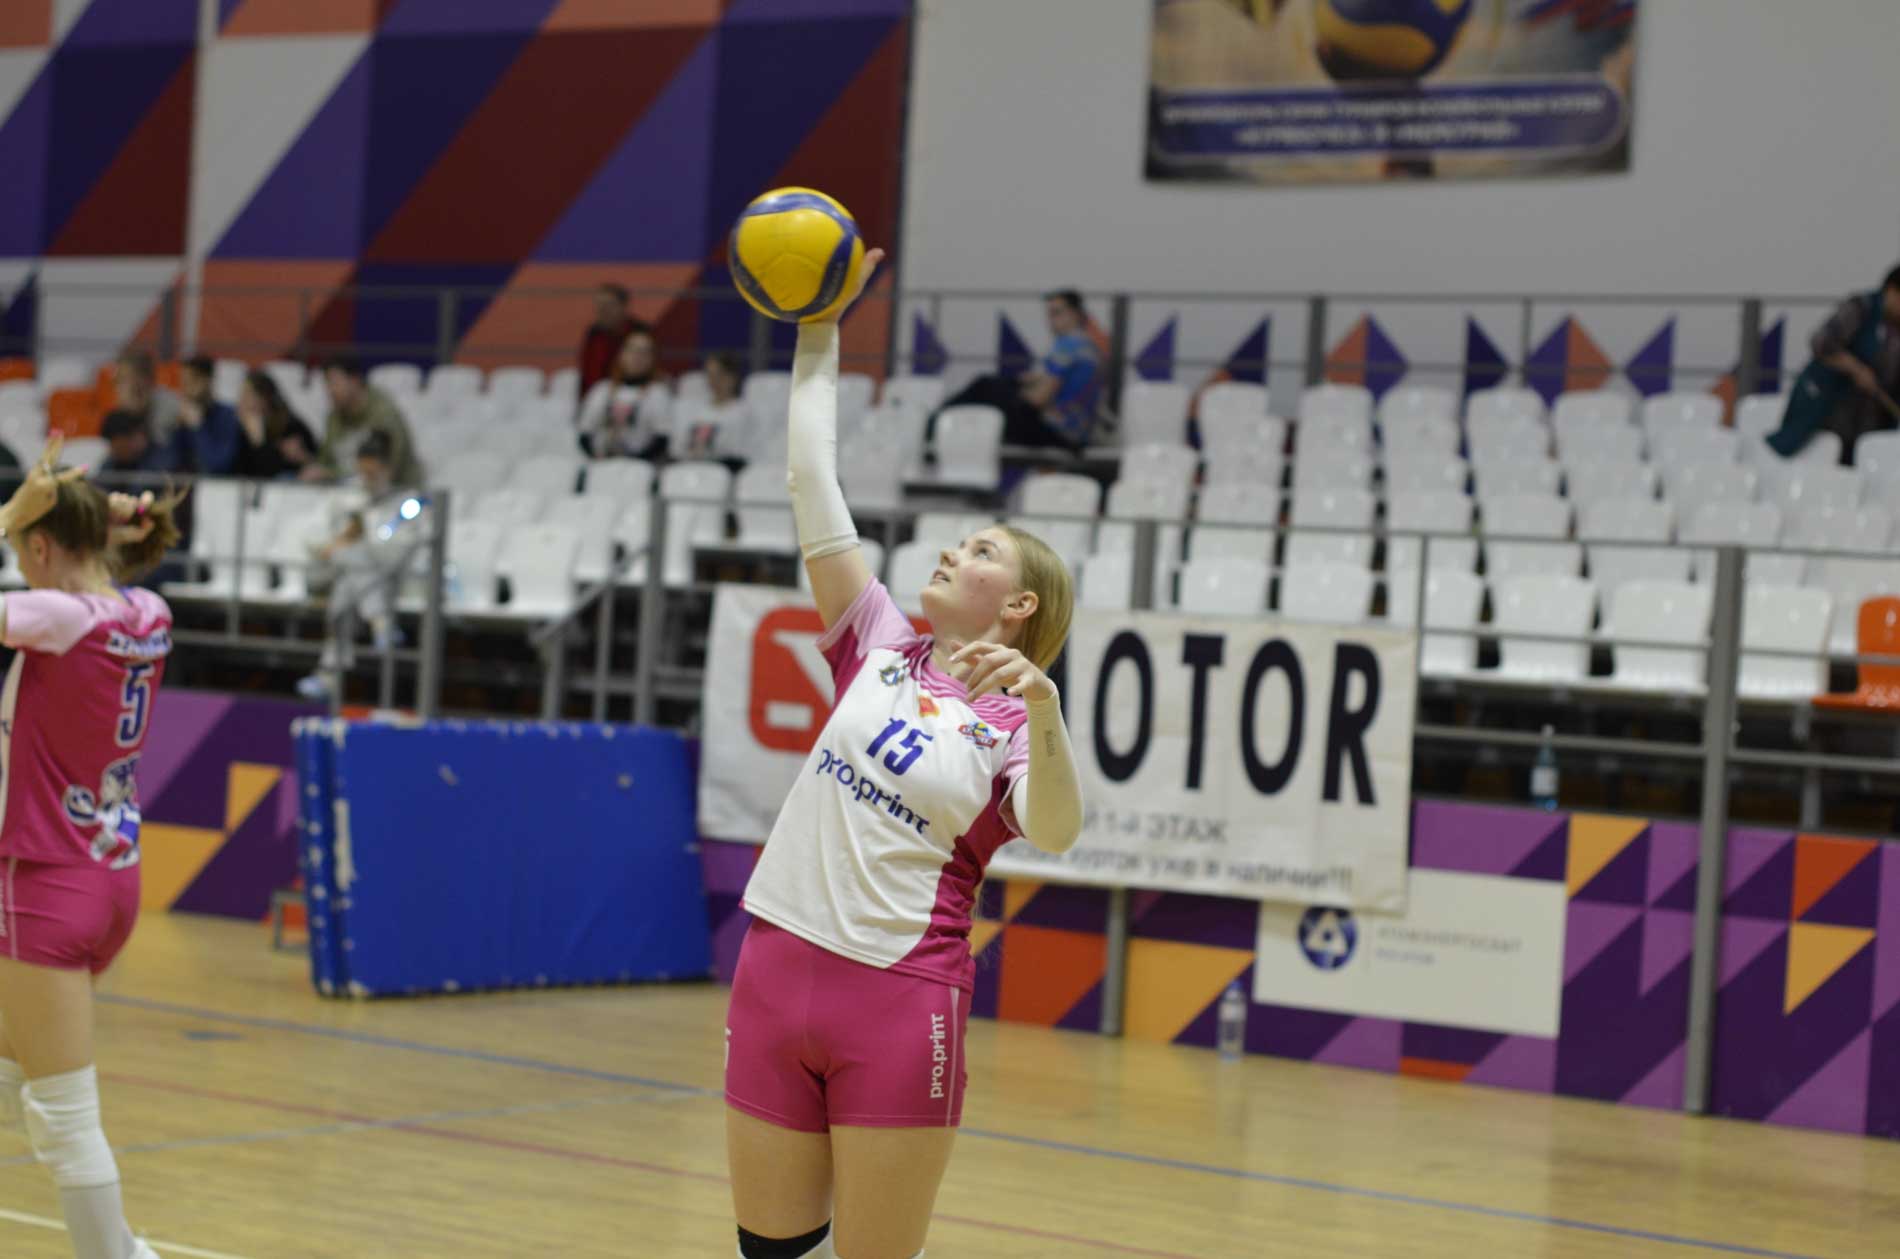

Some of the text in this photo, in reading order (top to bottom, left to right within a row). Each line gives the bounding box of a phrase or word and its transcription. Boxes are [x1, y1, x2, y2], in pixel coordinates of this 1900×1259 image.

[116, 663, 155, 746] 5
[1046, 629, 1381, 806] OTOR
[865, 717, 934, 776] 15
[816, 748, 931, 835] pro.print
[1147, 812, 1229, 844] ЭТАЖ
[1150, 856, 1197, 878] уже
[929, 1012, 949, 1099] pro.print
